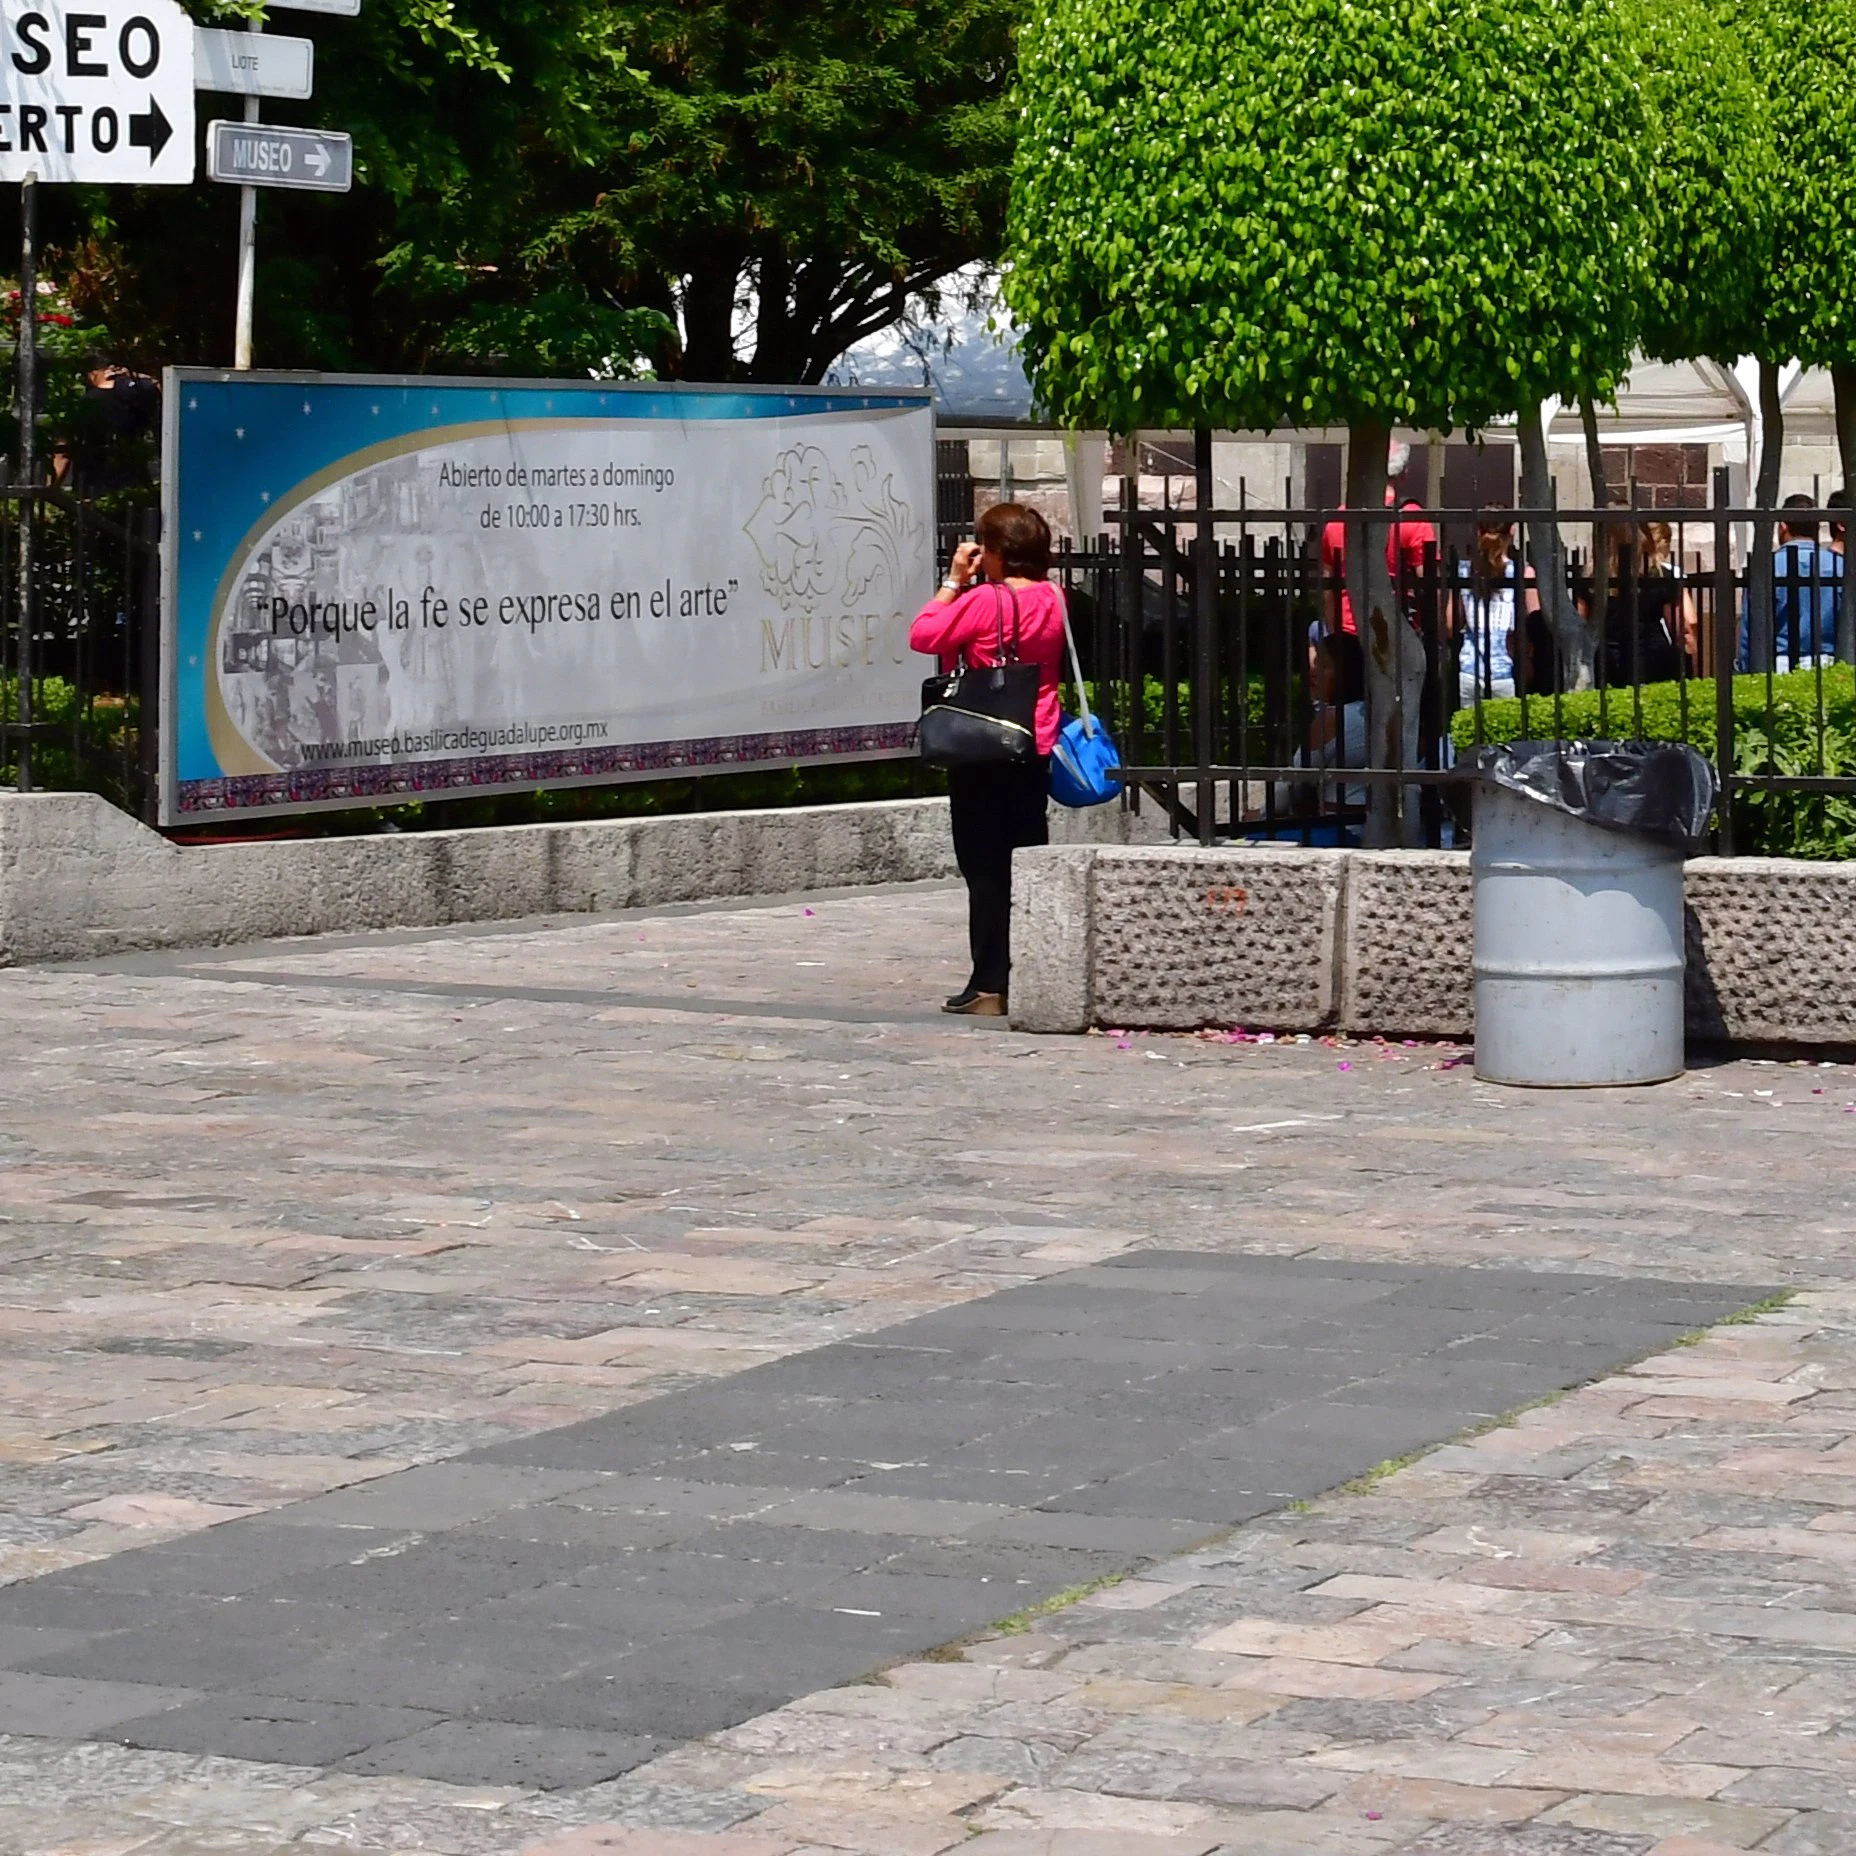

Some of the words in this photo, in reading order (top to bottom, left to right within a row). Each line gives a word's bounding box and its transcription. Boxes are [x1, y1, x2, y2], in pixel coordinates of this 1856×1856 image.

[11, 11, 160, 79] SEO
[233, 138, 292, 172] MUSEO
[439, 461, 502, 487] Abierto
[505, 461, 527, 487] de
[531, 465, 586, 487] martes
[590, 468, 599, 487] a
[602, 461, 675, 493] domingo
[479, 503, 502, 528] de
[507, 503, 550, 528] 10:00
[553, 510, 563, 528] a
[568, 503, 609, 527] 17:30
[614, 501, 642, 527] hrs.
[256, 596, 377, 644] “Porque
[388, 587, 409, 630] la
[420, 585, 448, 629] fe
[458, 596, 489, 627] se
[498, 592, 601, 634] expresa
[610, 591, 641, 620] en
[650, 578, 671, 618] el
[680, 578, 739, 617] arte”
[760, 611, 907, 672] MUSEO
[301, 721, 608, 761] www.museo.basilicadeguadalupe.org.mx
